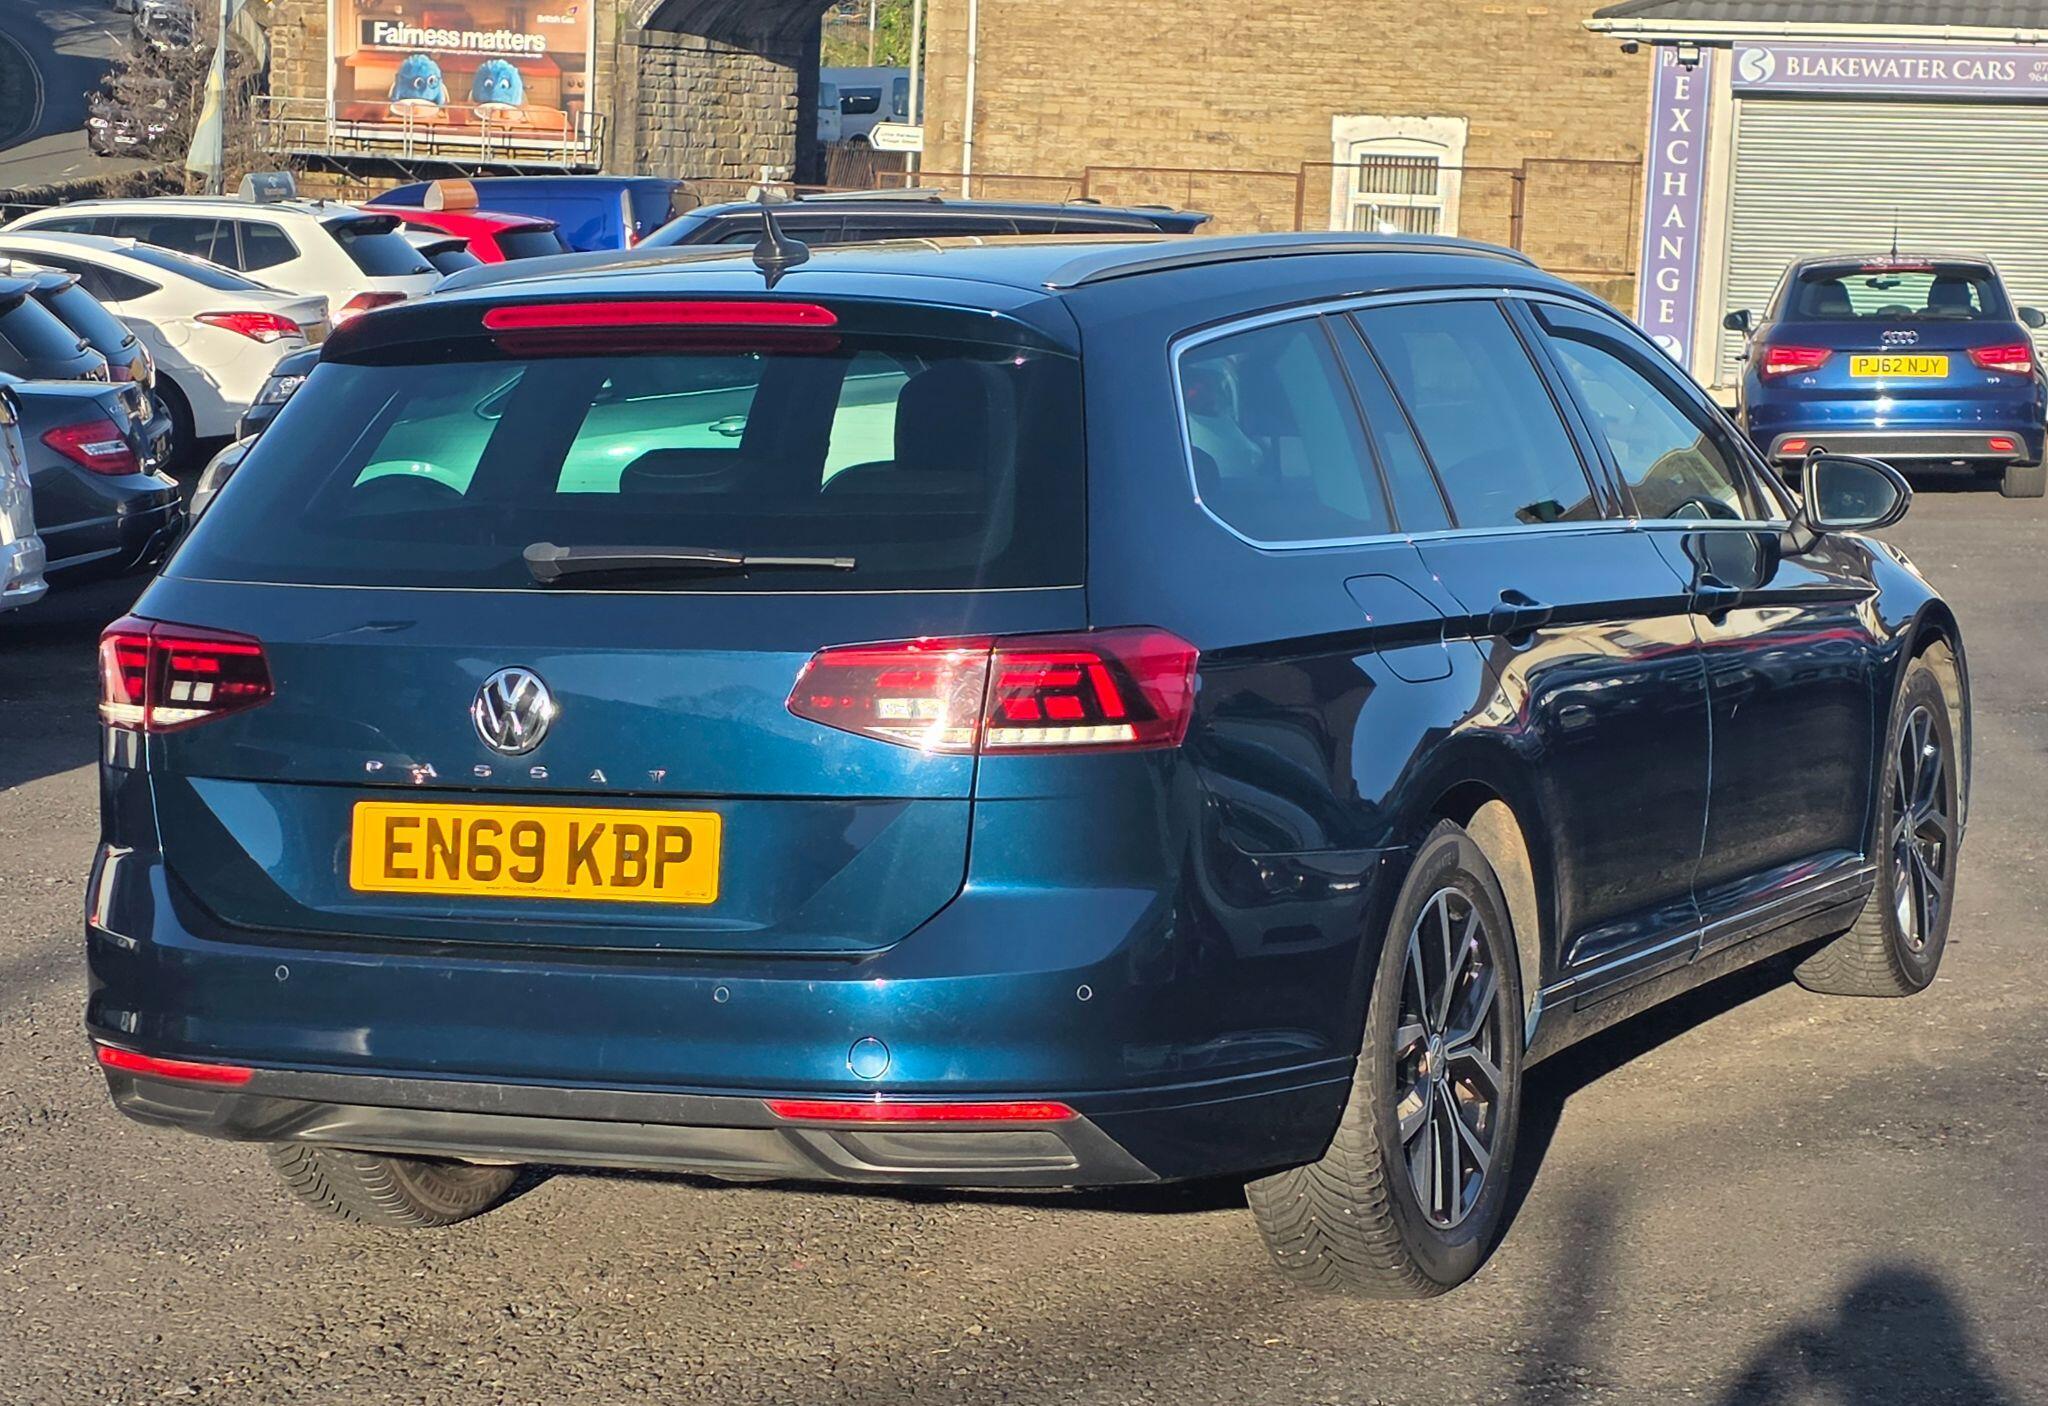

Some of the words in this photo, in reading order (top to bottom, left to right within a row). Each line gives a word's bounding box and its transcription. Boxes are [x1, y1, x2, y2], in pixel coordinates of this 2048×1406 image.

[373, 21, 460, 48] Fairness
[462, 28, 546, 51] matters
[1663, 51, 1707, 68] PT
[1786, 56, 1948, 79] BLAKEWATER
[1953, 60, 2016, 81] CARS
[1656, 76, 1693, 323] EXCHANGE
[1859, 358, 1902, 373] PJ62
[1908, 359, 1941, 373] NJY
[364, 760, 668, 784] PASSAT
[384, 816, 546, 884] EN69
[566, 821, 693, 889] KBP
